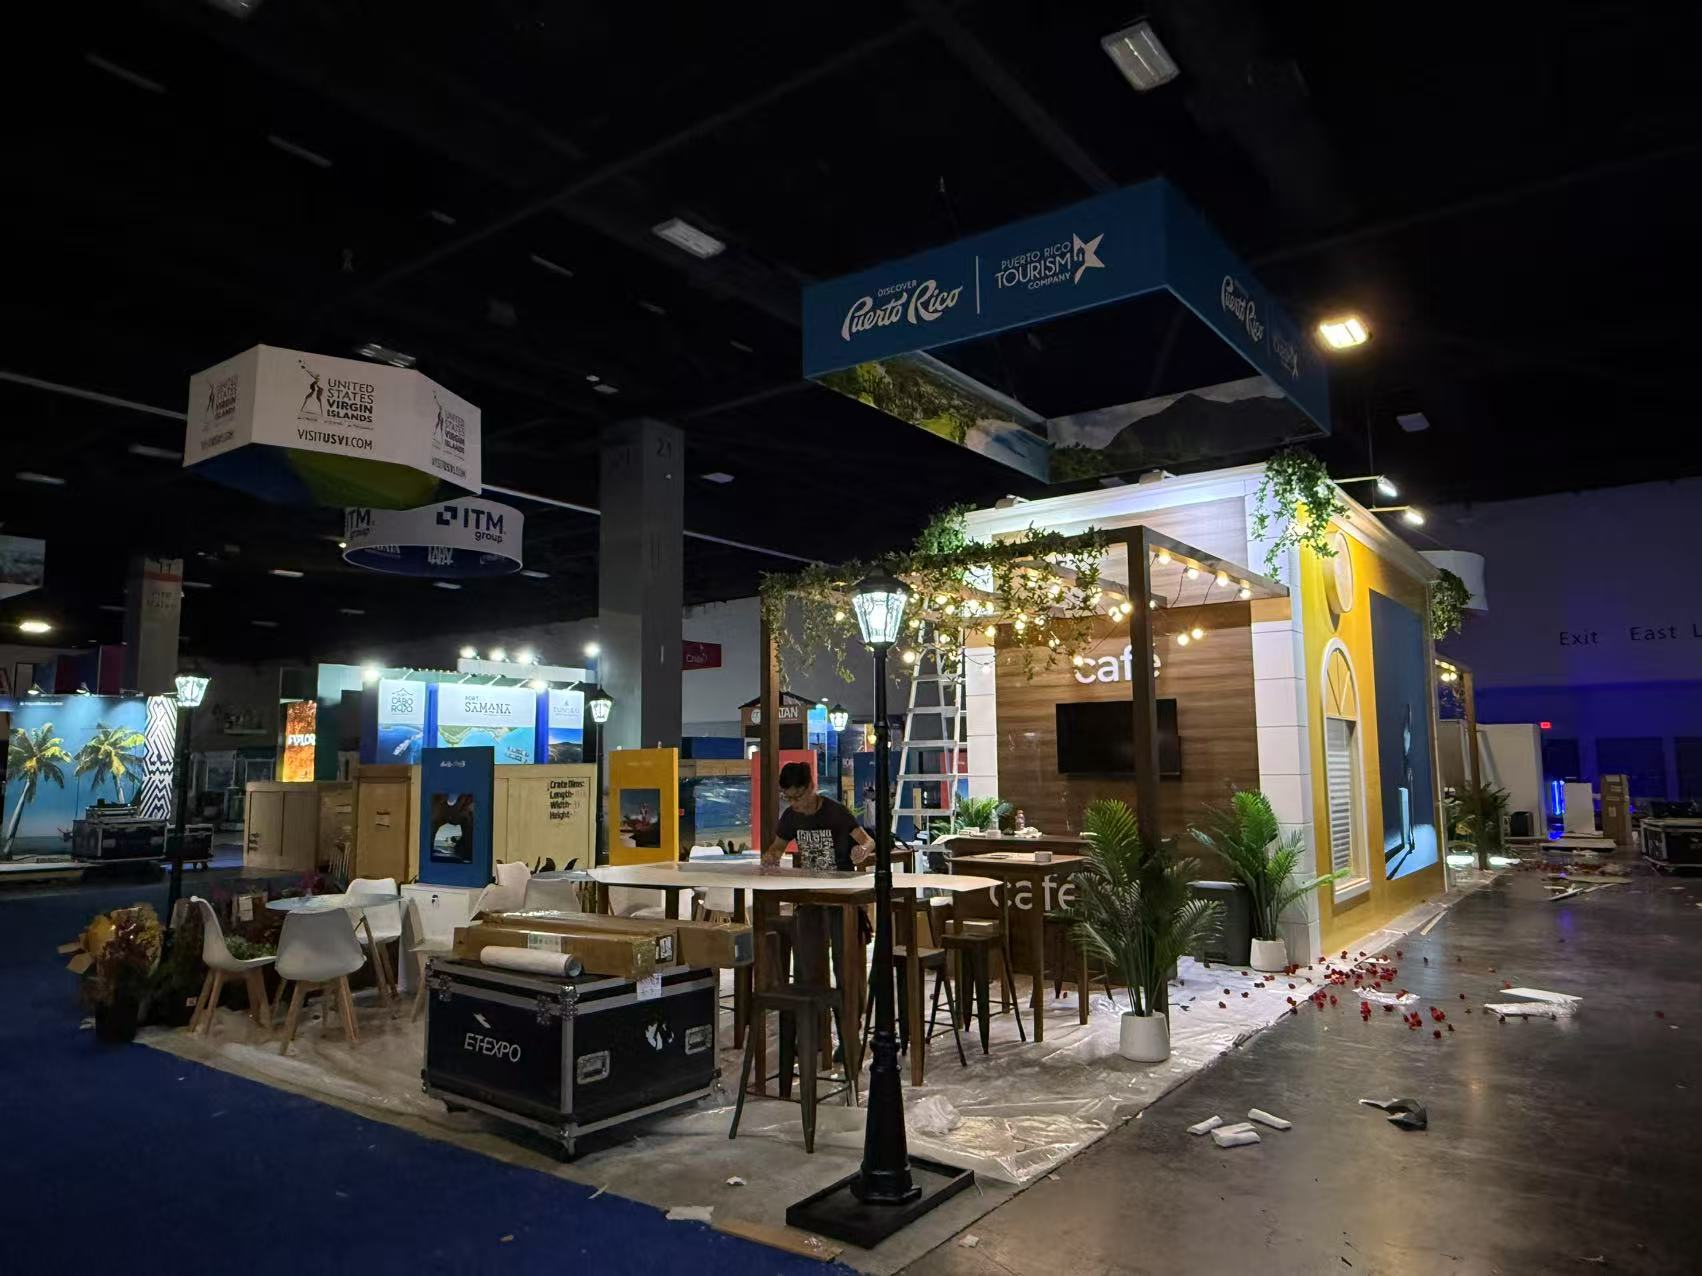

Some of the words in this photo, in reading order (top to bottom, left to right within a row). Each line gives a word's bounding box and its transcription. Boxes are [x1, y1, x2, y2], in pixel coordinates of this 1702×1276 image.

[1001, 251, 1040, 270] PUERTO
[1044, 241, 1072, 257] RICO
[995, 253, 1071, 289] TOURISM
[877, 279, 917, 297] DISCOVER
[1027, 271, 1071, 290] COMPANY
[841, 296, 908, 341] Puerto
[907, 279, 964, 324] Rico
[327, 378, 375, 394] UNITED
[326, 388, 375, 405] STATES
[326, 398, 373, 415] VIRGIN
[327, 409, 373, 423] ISLANDS
[297, 428, 373, 451] VISITUSVI.COM
[463, 508, 504, 534] ITM
[475, 531, 503, 544] group
[1559, 631, 1599, 646] Exit
[1630, 626, 1677, 641] East
